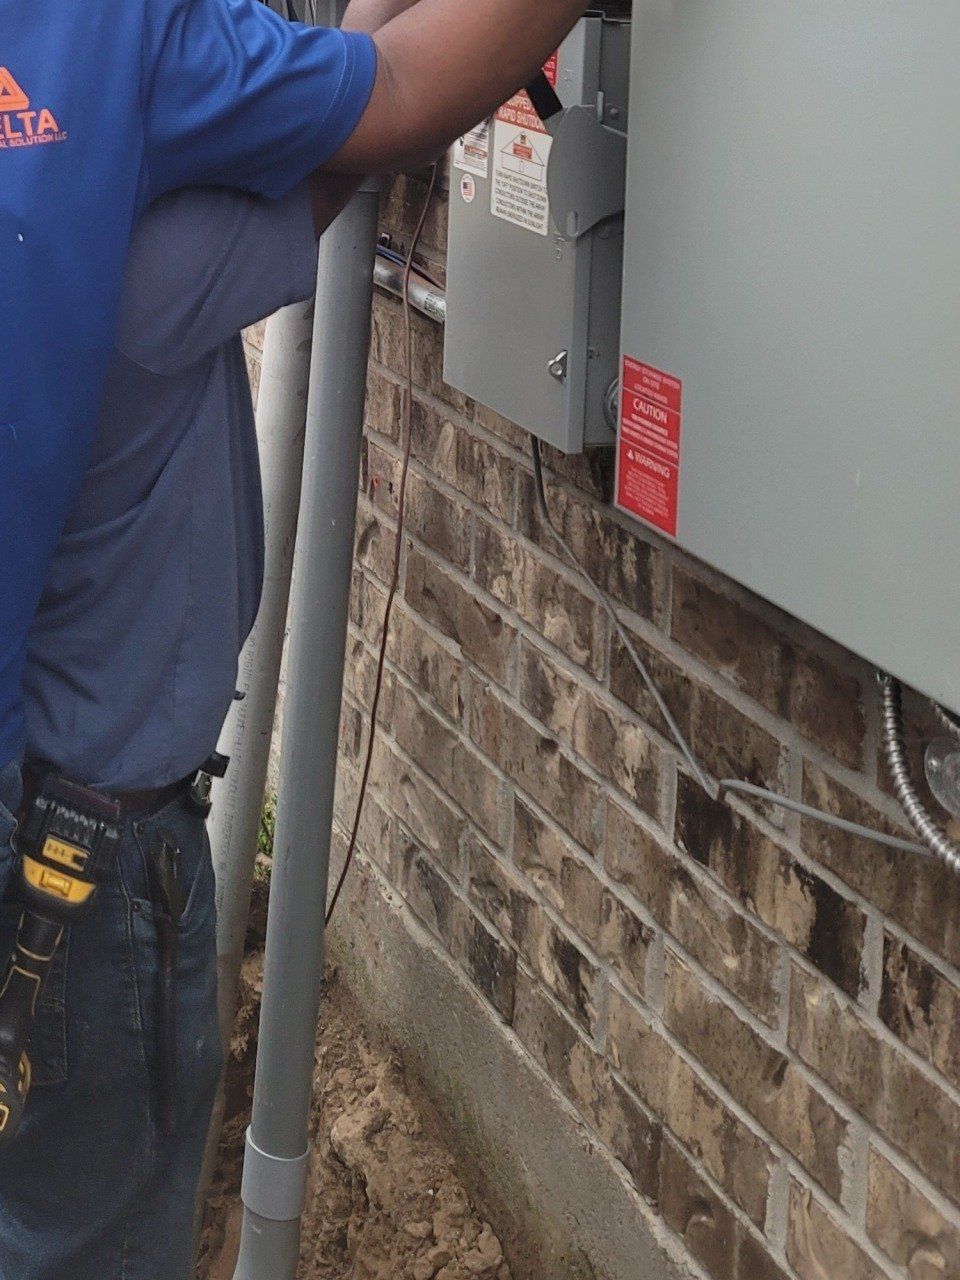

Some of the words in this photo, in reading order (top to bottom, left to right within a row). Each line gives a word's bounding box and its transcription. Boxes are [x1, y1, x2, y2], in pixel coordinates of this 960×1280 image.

[9, 133, 54, 148] SOLUTION
[633, 398, 667, 424] CAUTION
[635, 451, 669, 479] WARNING
